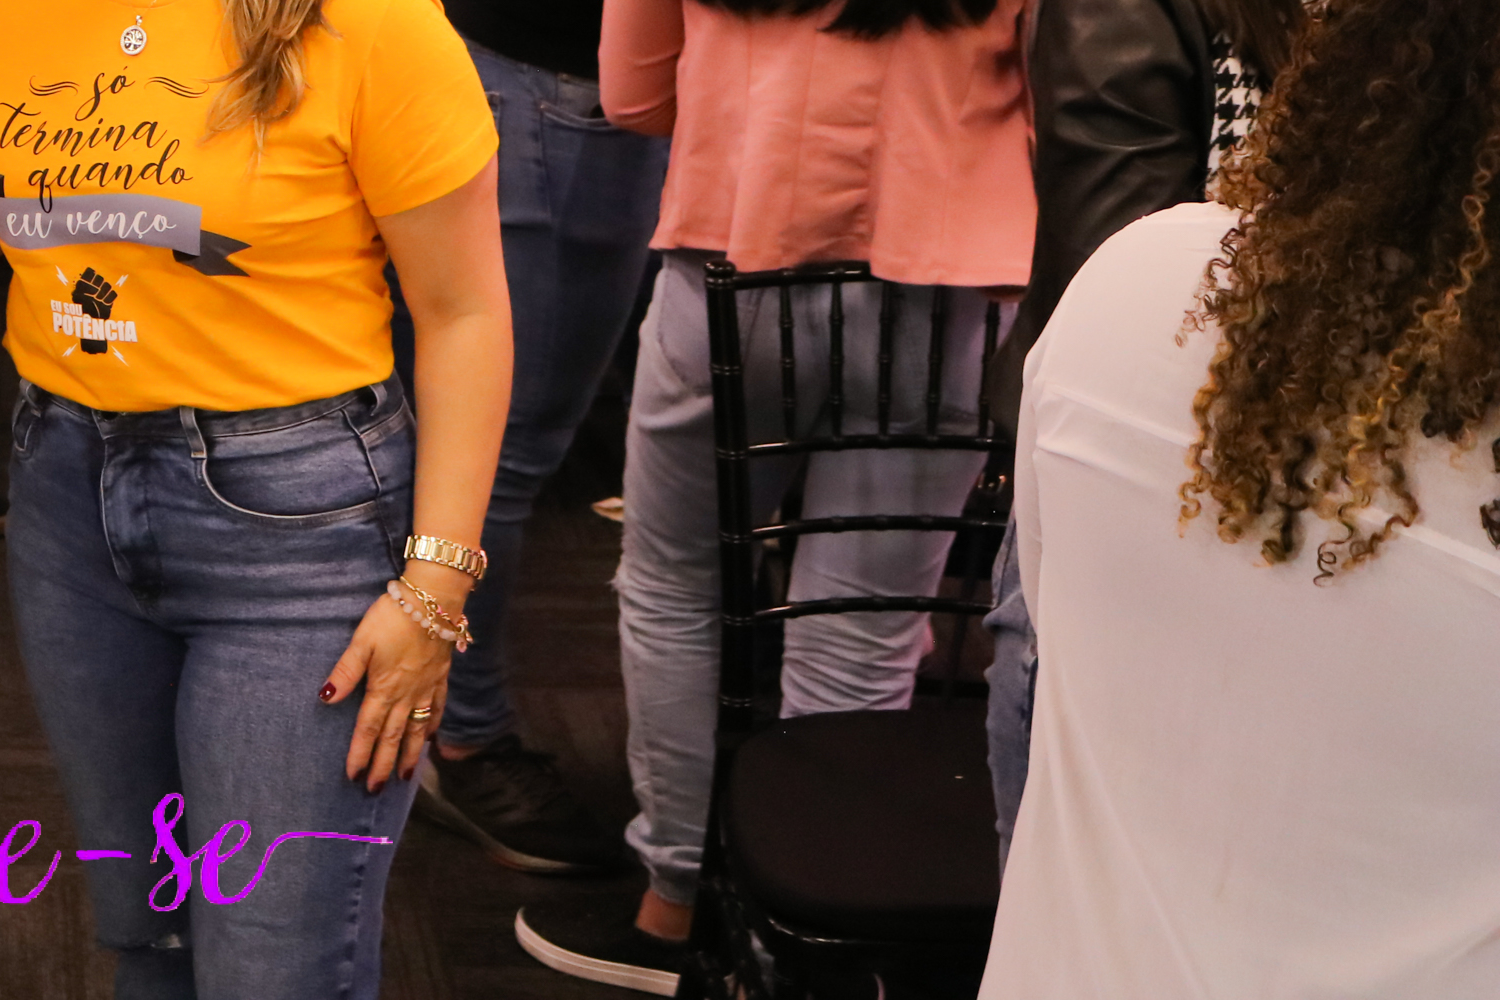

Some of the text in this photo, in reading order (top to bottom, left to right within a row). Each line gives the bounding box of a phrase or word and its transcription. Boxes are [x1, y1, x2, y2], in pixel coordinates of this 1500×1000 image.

[75, 66, 135, 121] só
[0, 102, 167, 157] termina
[28, 139, 193, 214] quando
[6, 209, 177, 239] eu venço
[50, 299, 83, 317] EU SOU
[52, 312, 138, 343] POTÊNCIA
